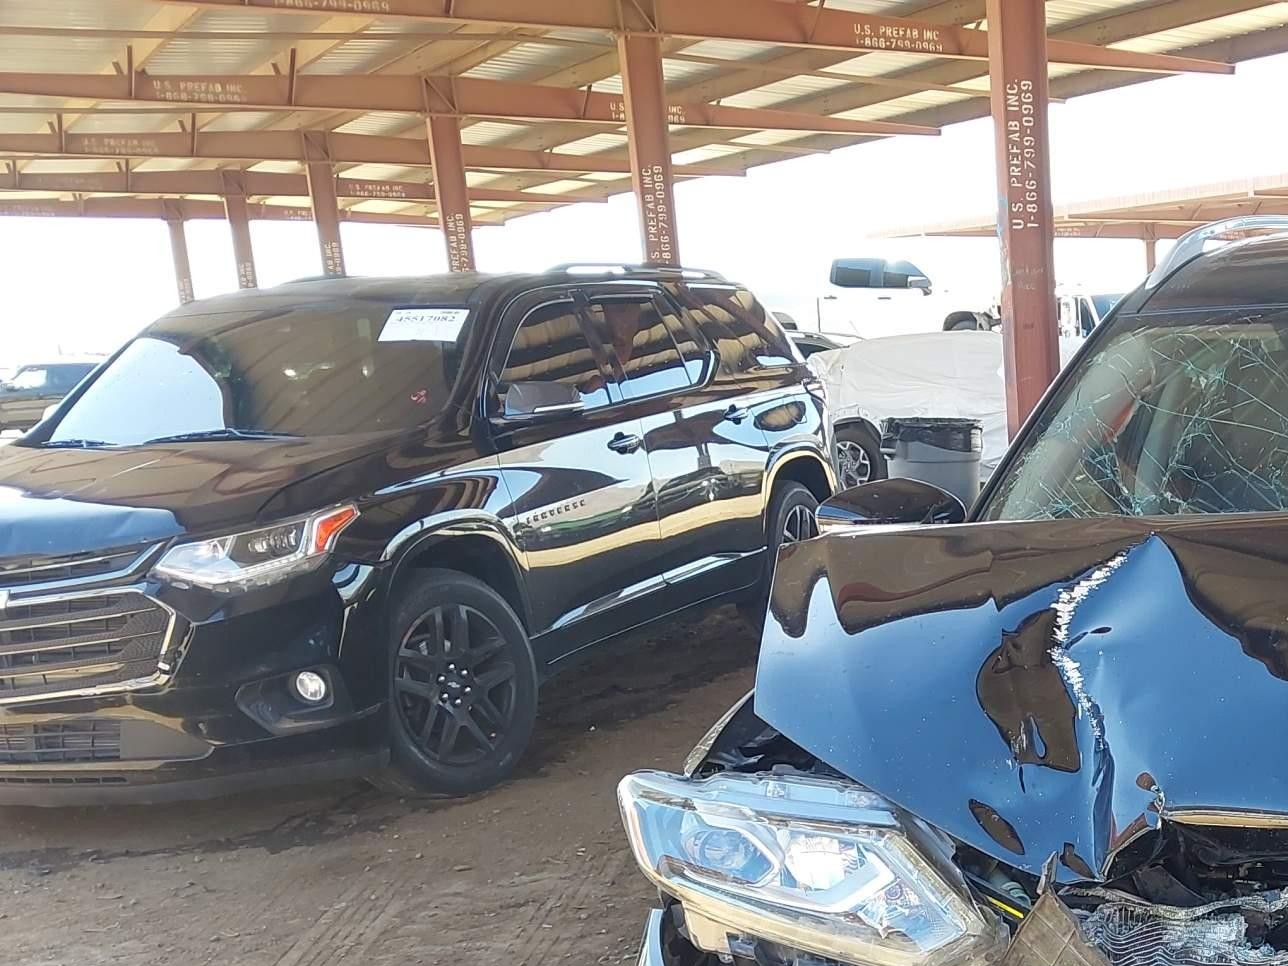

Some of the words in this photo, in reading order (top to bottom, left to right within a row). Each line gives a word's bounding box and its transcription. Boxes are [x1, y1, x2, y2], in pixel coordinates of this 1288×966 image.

[853, 23, 874, 37] U.S.
[879, 25, 919, 39] PREFAB
[1006, 78, 1020, 111] INC.
[1007, 120, 1023, 188] PREFAB
[1020, 80, 1040, 228] 1-866-799-0969
[641, 164, 653, 188] INC.
[644, 193, 659, 241] PREFAB
